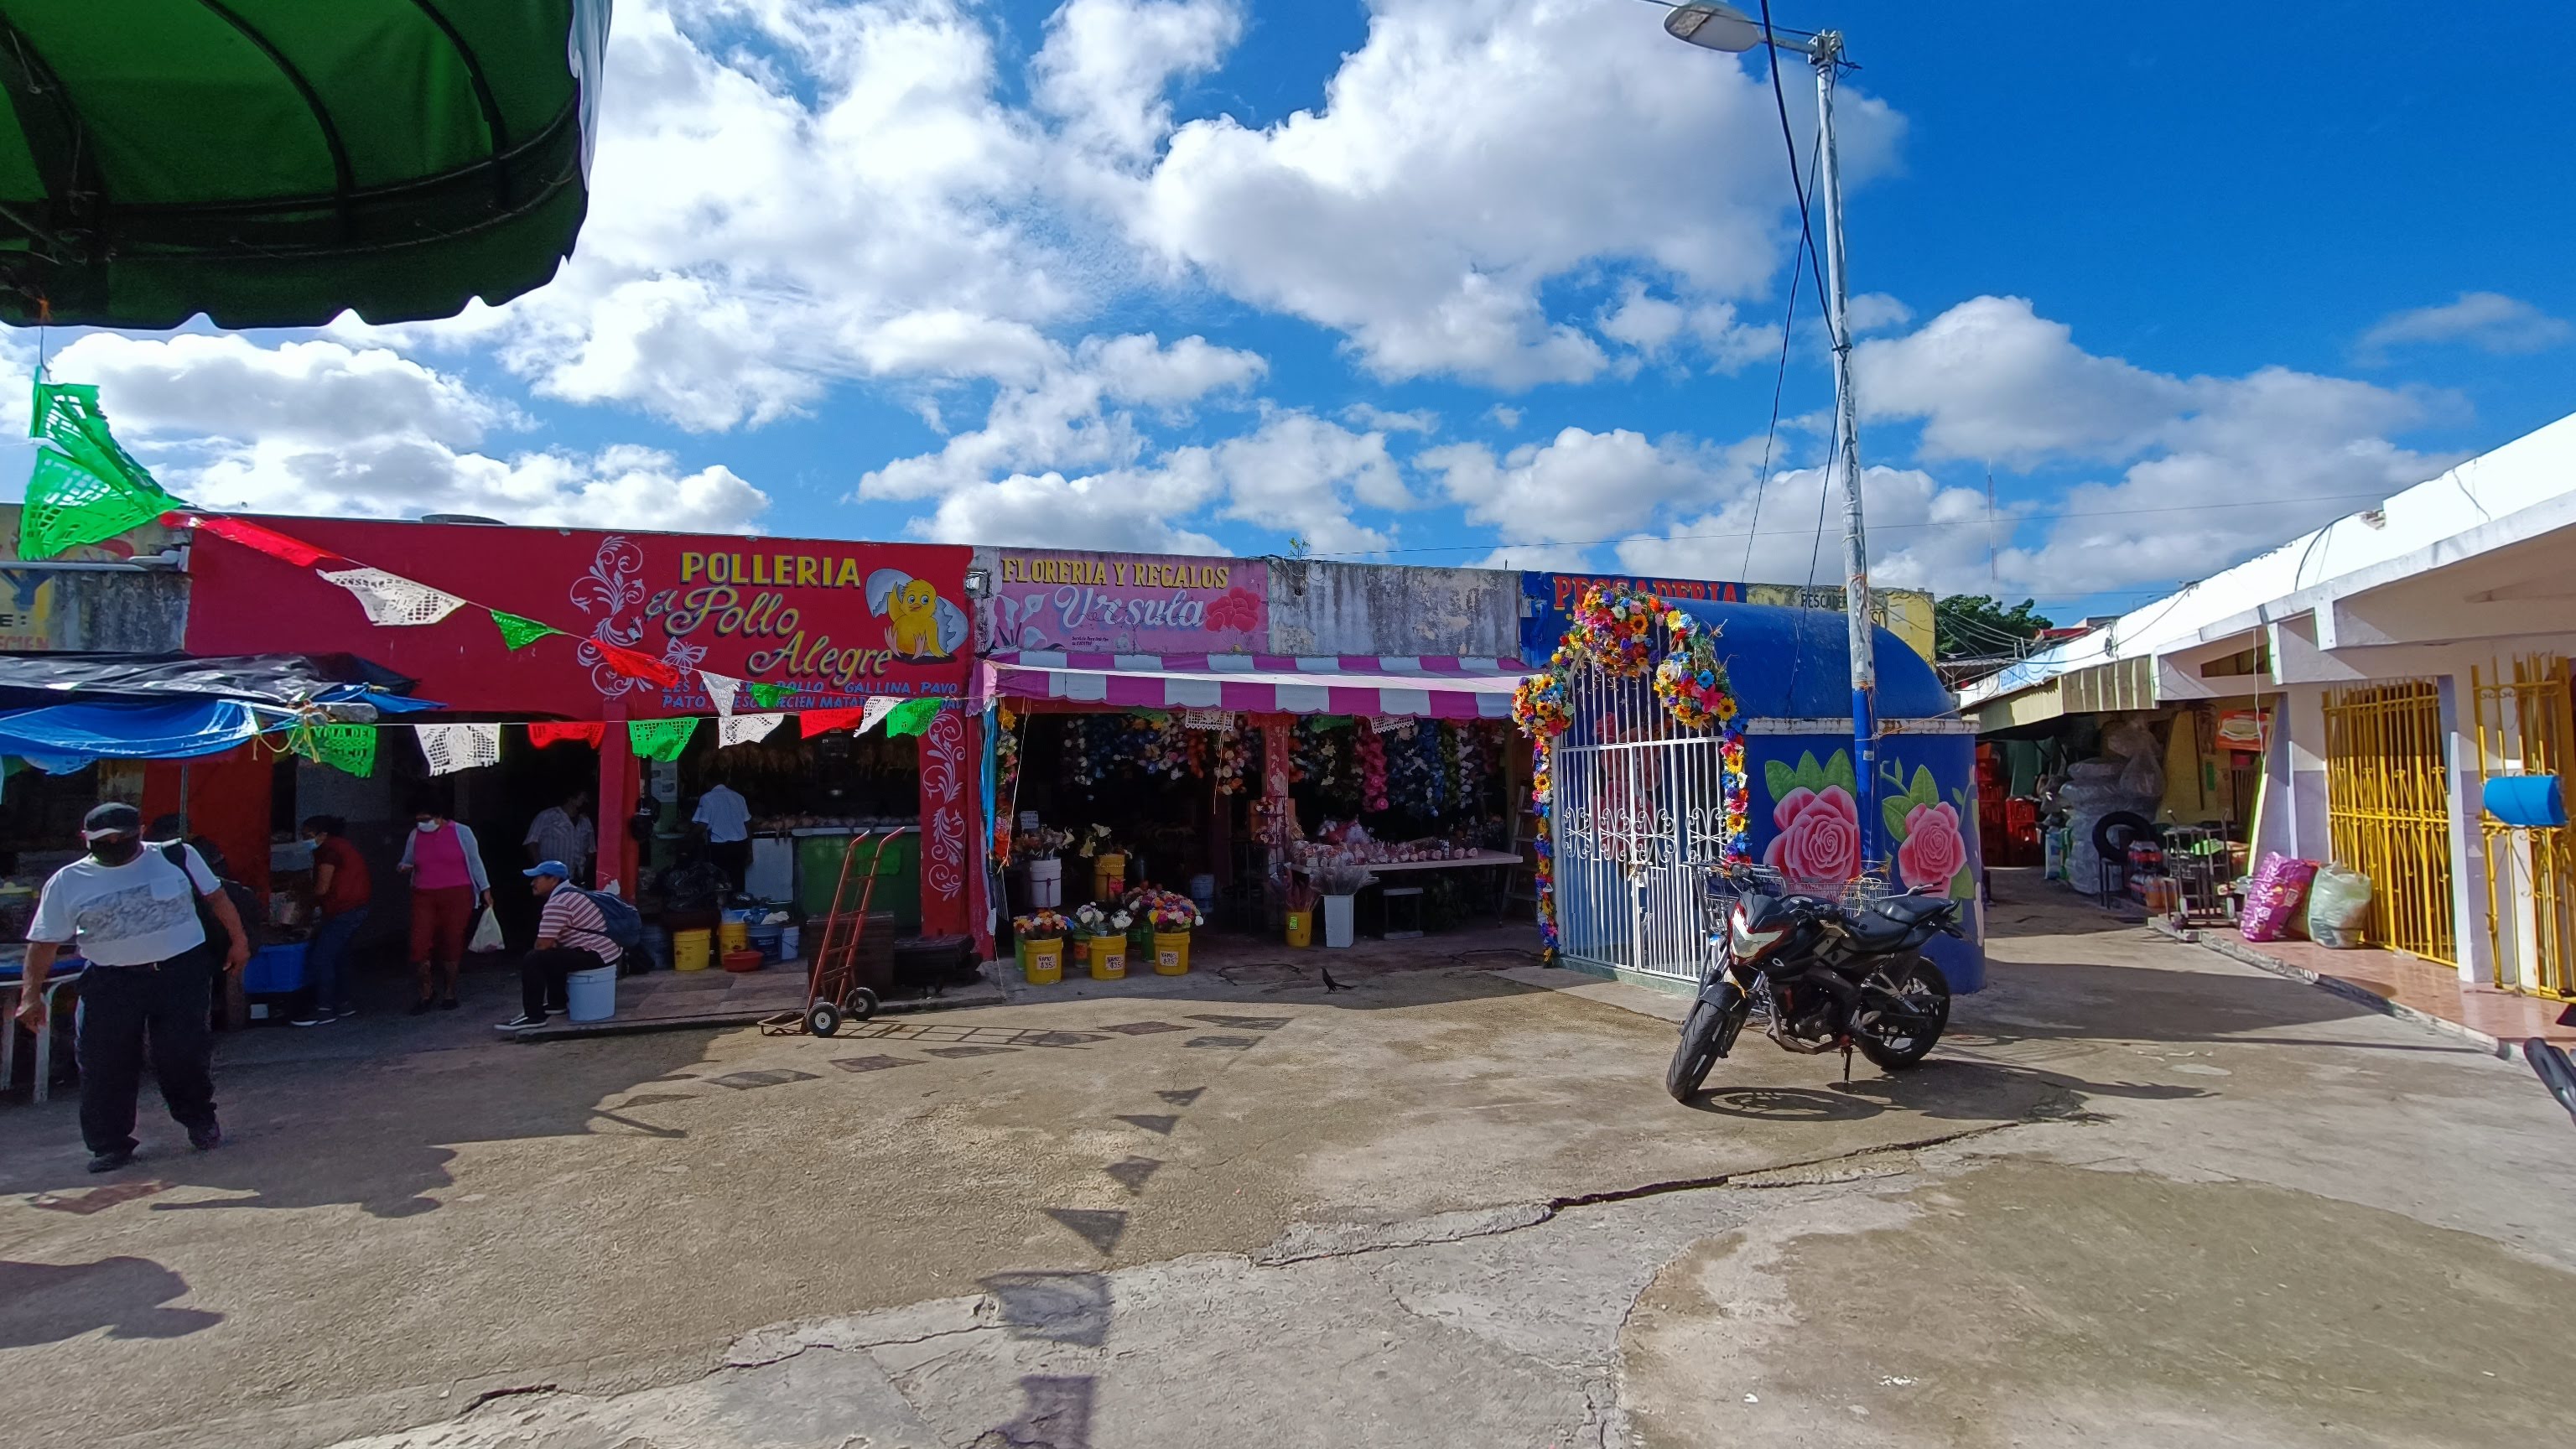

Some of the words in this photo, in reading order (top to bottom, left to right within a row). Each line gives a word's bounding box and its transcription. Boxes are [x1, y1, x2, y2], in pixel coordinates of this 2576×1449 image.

[680, 551, 860, 587] POLLERIA
[1001, 558, 1108, 586] FLORERIA
[1112, 563, 1129, 587] Y
[1133, 564, 1229, 589] REGALOS
[646, 587, 678, 621] El
[664, 585, 800, 637] Pollo
[1053, 584, 1205, 629] Ursula
[745, 629, 894, 688] Alegre
